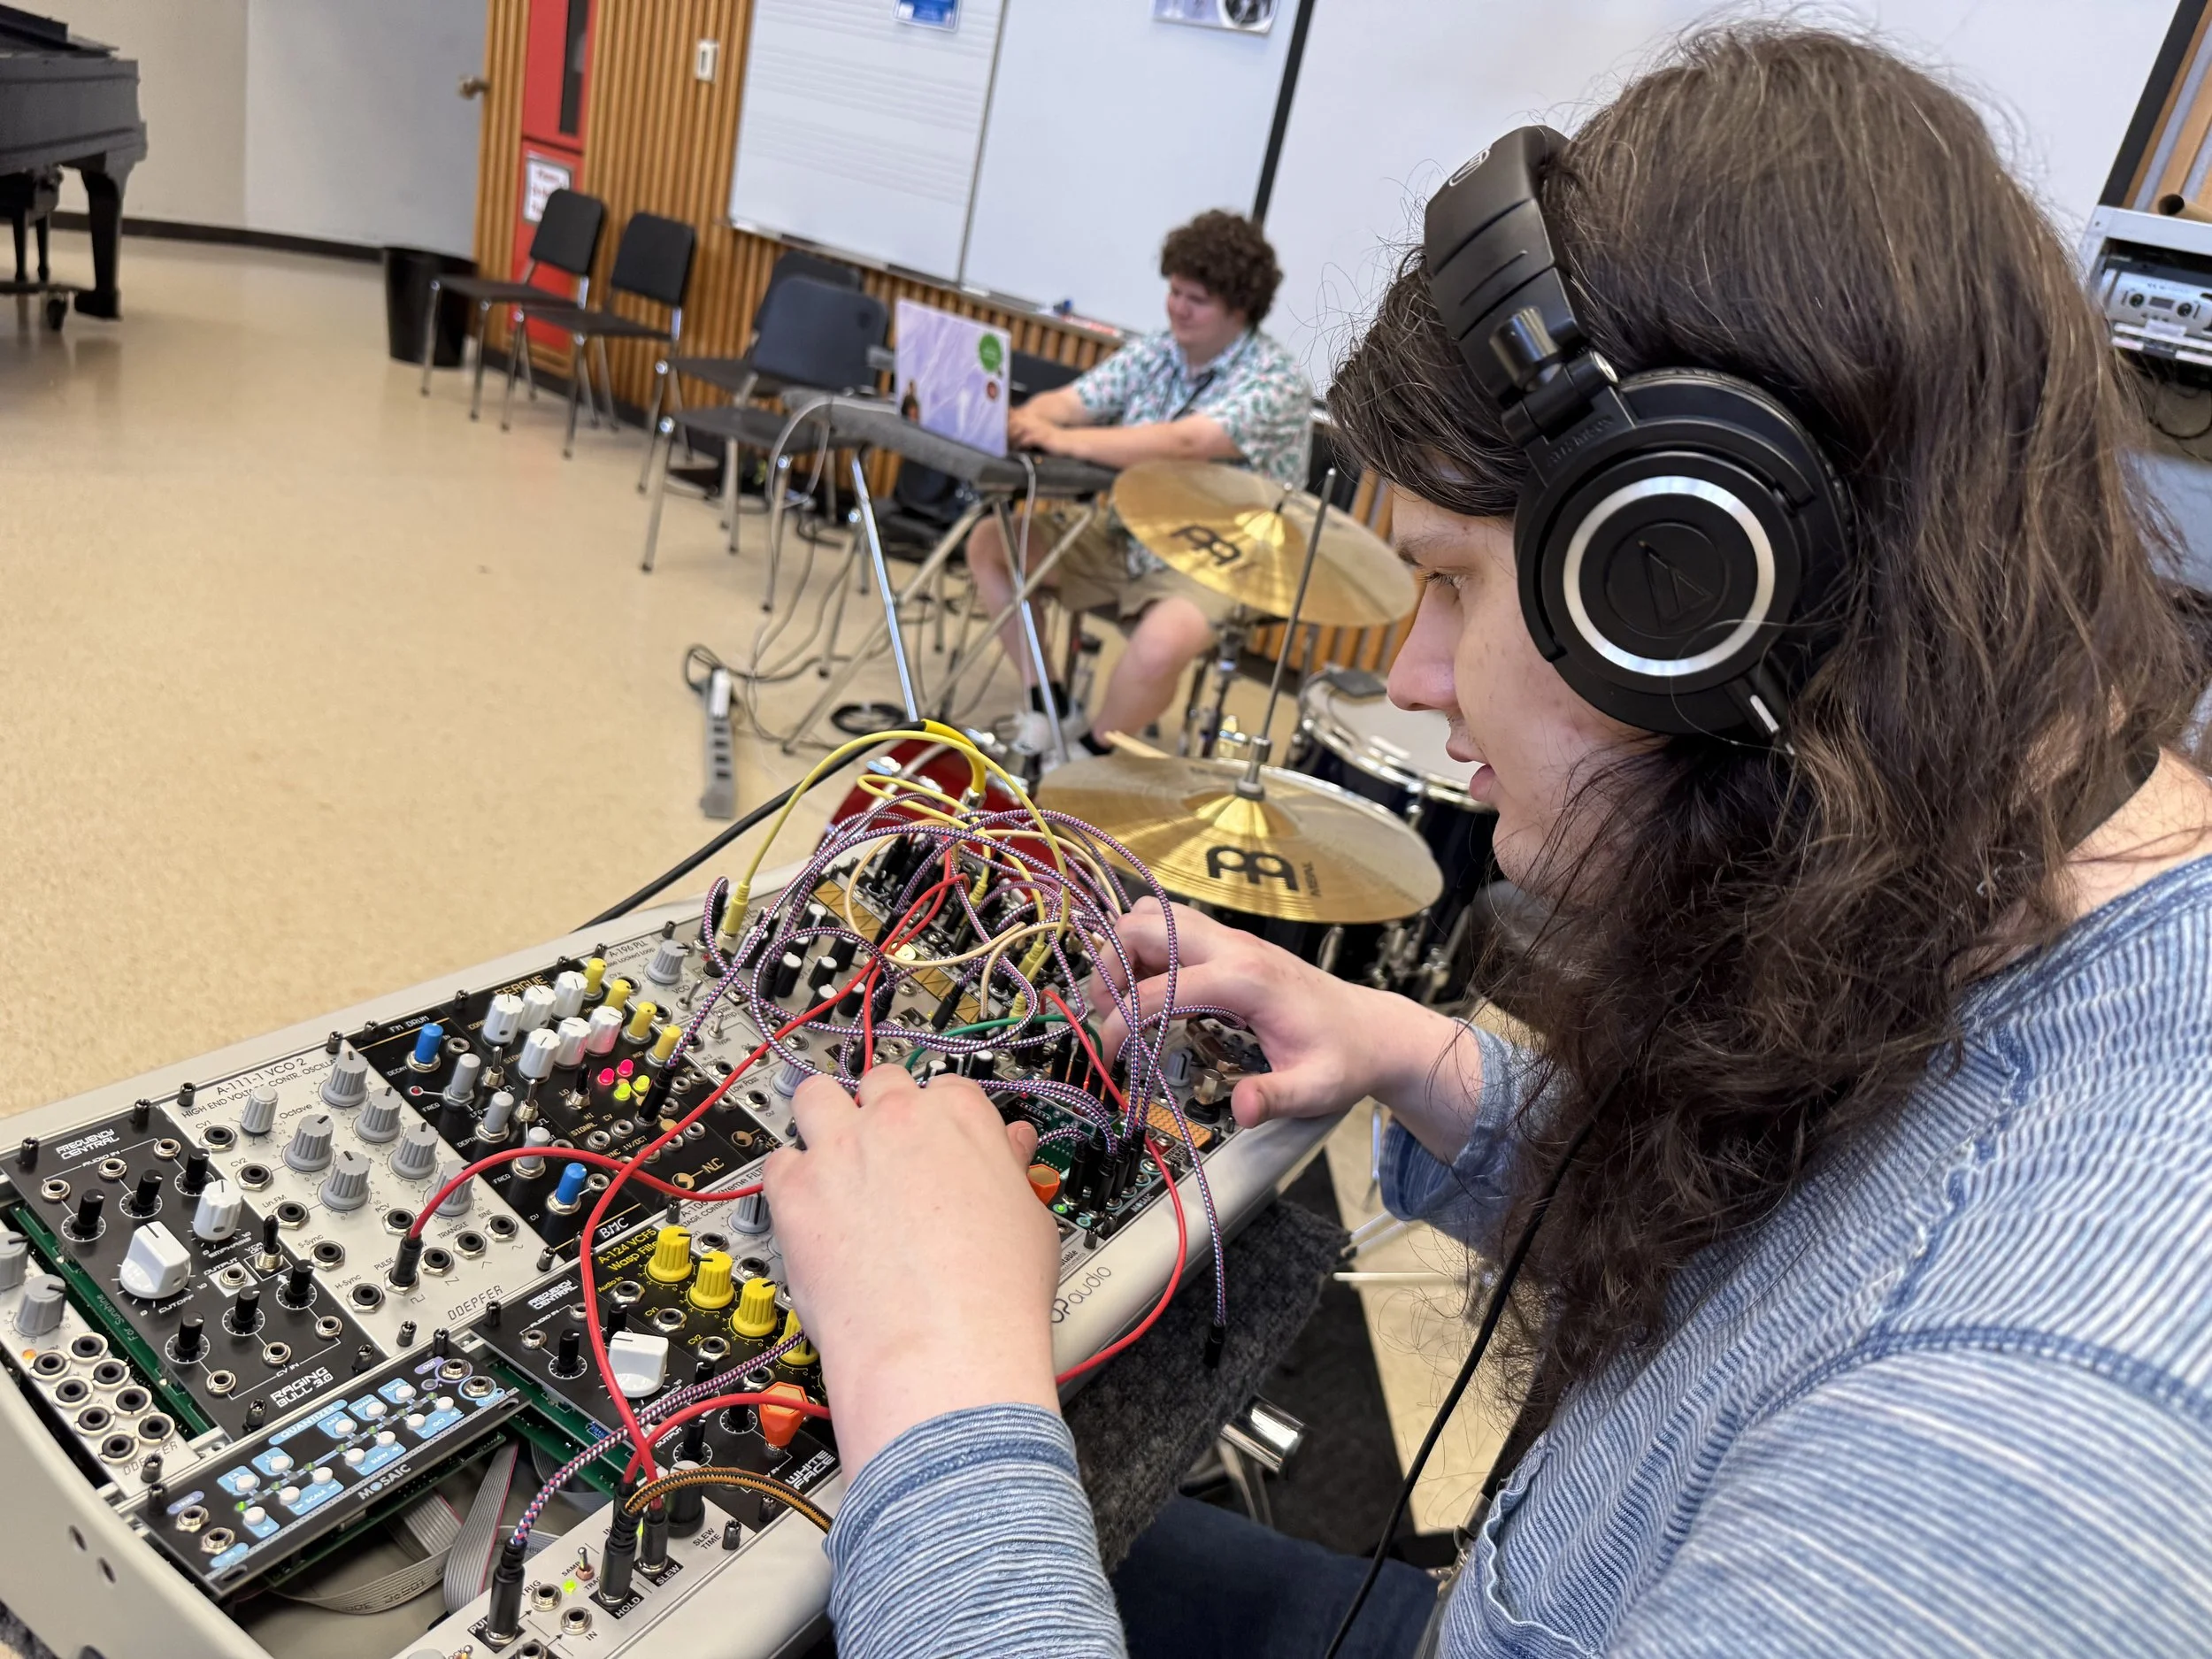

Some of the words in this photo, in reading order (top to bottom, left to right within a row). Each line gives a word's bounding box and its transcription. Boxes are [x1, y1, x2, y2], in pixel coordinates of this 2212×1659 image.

[609, 946, 633, 957] A-196
[633, 940, 649, 949] PLL
[672, 984, 690, 995] VCO
[710, 1005, 732, 1016] Phase
[405, 1015, 430, 1029] DRUM
[716, 1037, 733, 1047] Type
[217, 1072, 265, 1095] A-111-1
[265, 1061, 296, 1078] VCO
[294, 1057, 307, 1067] 2
[387, 1065, 408, 1078] DECAY
[180, 1105, 209, 1119] HIGH
[209, 1097, 228, 1110] END
[268, 1071, 303, 1087] CONTR.
[302, 1057, 338, 1075] OSCILLA
[729, 1081, 745, 1093] Low
[744, 1076, 759, 1087] Pass
[279, 1103, 312, 1119] Octave
[422, 1102, 441, 1112] FREQ
[196, 1120, 211, 1129] CV1
[570, 1121, 598, 1136] SIGNAL
[55, 1128, 115, 1154] FREQUENCY
[60, 1137, 120, 1160] CENTRAL
[457, 1135, 479, 1148] DEPTH
[623, 1135, 648, 1150] 1V/OCT
[82, 1154, 109, 1167] AUDIO
[230, 1157, 248, 1168] CV2
[493, 1173, 511, 1185] FREQ
[262, 1194, 288, 1209] Lin.FM
[374, 1203, 391, 1214] PCV
[478, 1209, 494, 1219] SINE
[437, 1221, 469, 1240] TRIANGLE
[599, 1217, 629, 1240] BMC
[208, 1237, 252, 1258] EMPHASIS
[297, 1234, 324, 1248] S-Sync
[597, 1244, 630, 1265] A-124
[626, 1228, 657, 1247] VCF5
[204, 1257, 239, 1276] OUTPUT
[373, 1256, 396, 1271] PULSE
[607, 1252, 641, 1271] Wasp
[334, 1273, 362, 1290] H-Sync
[597, 1279, 618, 1293] Audio
[1067, 1265, 1112, 1305] audio
[158, 1294, 194, 1314] CUTOFF
[447, 1285, 503, 1321] DOEPFER
[534, 1285, 579, 1310] CENTRAL
[96, 1294, 125, 1325] Sunshine
[644, 1307, 659, 1317] CV1
[124, 1328, 139, 1341] For
[687, 1333, 703, 1346] CV2
[275, 1366, 289, 1378] CV
[422, 1361, 437, 1371] OUT
[270, 1366, 330, 1402] RAGING
[274, 1386, 313, 1409] BULL
[313, 1373, 334, 1388] 3.0
[280, 1404, 338, 1438] QUANTIZER
[432, 1417, 446, 1427] OCT
[654, 1427, 683, 1449] OUTPUT
[123, 1440, 178, 1476] DOEFER
[785, 1449, 830, 1484] WHITE
[357, 1463, 411, 1501] MOSAIC
[793, 1456, 836, 1491] FACE
[303, 1489, 326, 1504] SCALE
[692, 1527, 716, 1548] SLEW
[700, 1532, 724, 1550] TIME
[655, 1563, 682, 1586] SLEW
[614, 1595, 641, 1618] HOLD
[585, 1631, 598, 1642] IN
